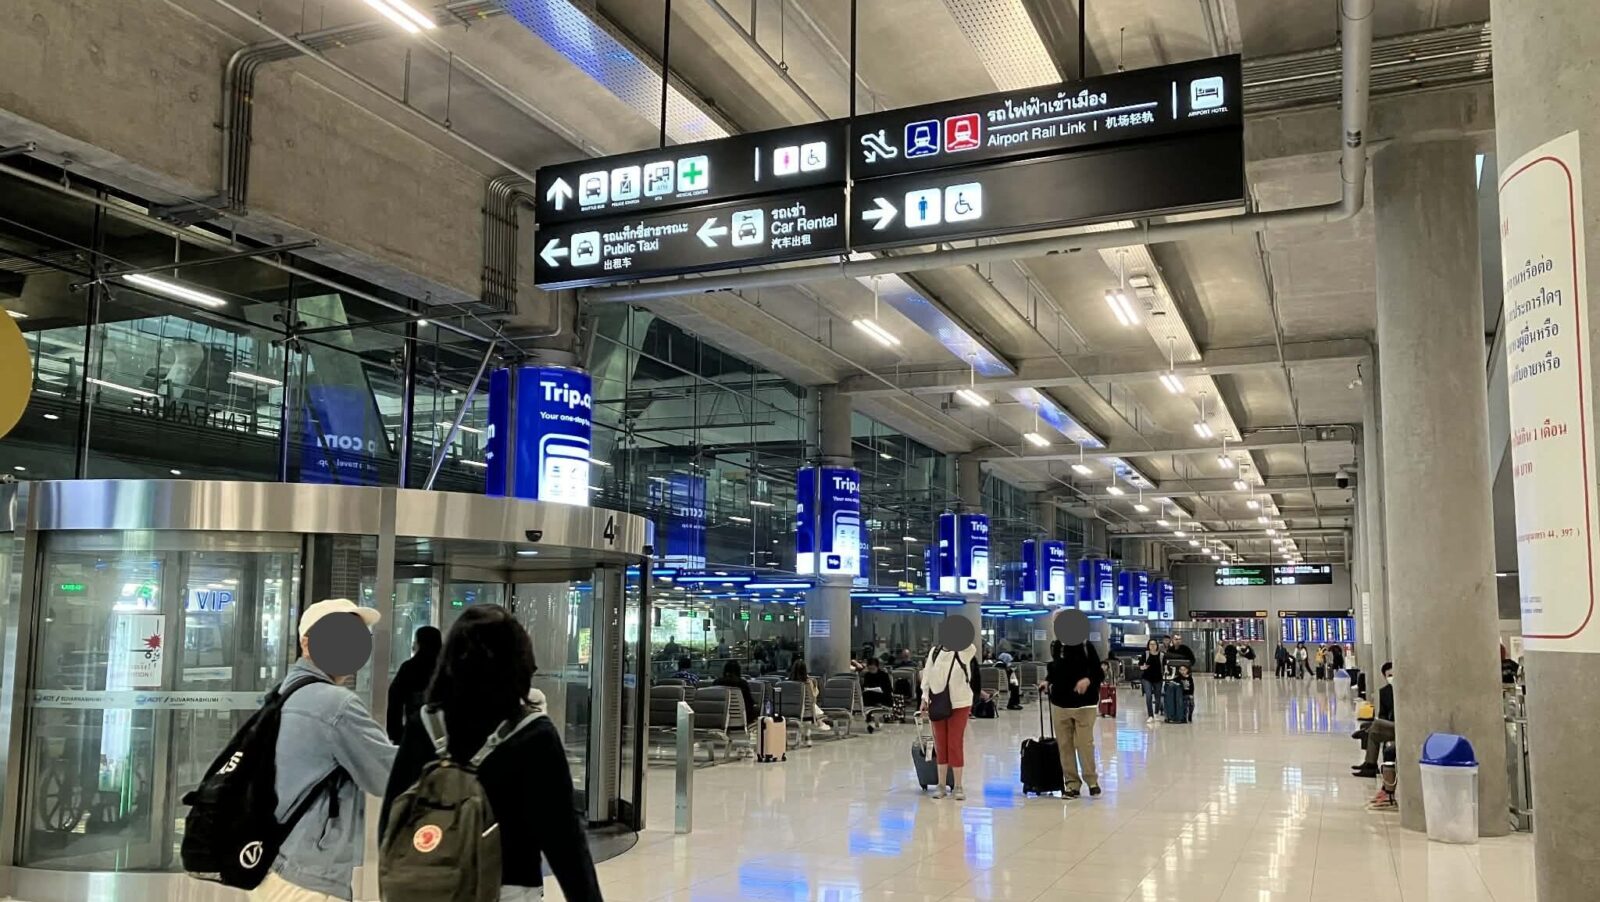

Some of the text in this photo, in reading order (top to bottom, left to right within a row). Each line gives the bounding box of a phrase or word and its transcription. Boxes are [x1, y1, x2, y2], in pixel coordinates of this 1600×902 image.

[987, 89, 1107, 122] รถไฟฟ้าเข้าเมือง
[1105, 110, 1154, 130] 机场轻轨
[987, 121, 1086, 147] Airport Rail Link
[771, 202, 806, 220] รถเช่า
[603, 221, 689, 242] รถแท็กซี่สาธารณะ
[771, 213, 838, 235] Car Rental
[604, 238, 660, 256] Public Taxi
[771, 234, 812, 249] 汽车出租
[604, 257, 632, 270] 出租车
[540, 411, 559, 420] Your
[1534, 428, 1537, 441] 1
[1540, 418, 1567, 440] เดือน
[604, 515, 614, 545] 4
[196, 590, 233, 613] VIP
